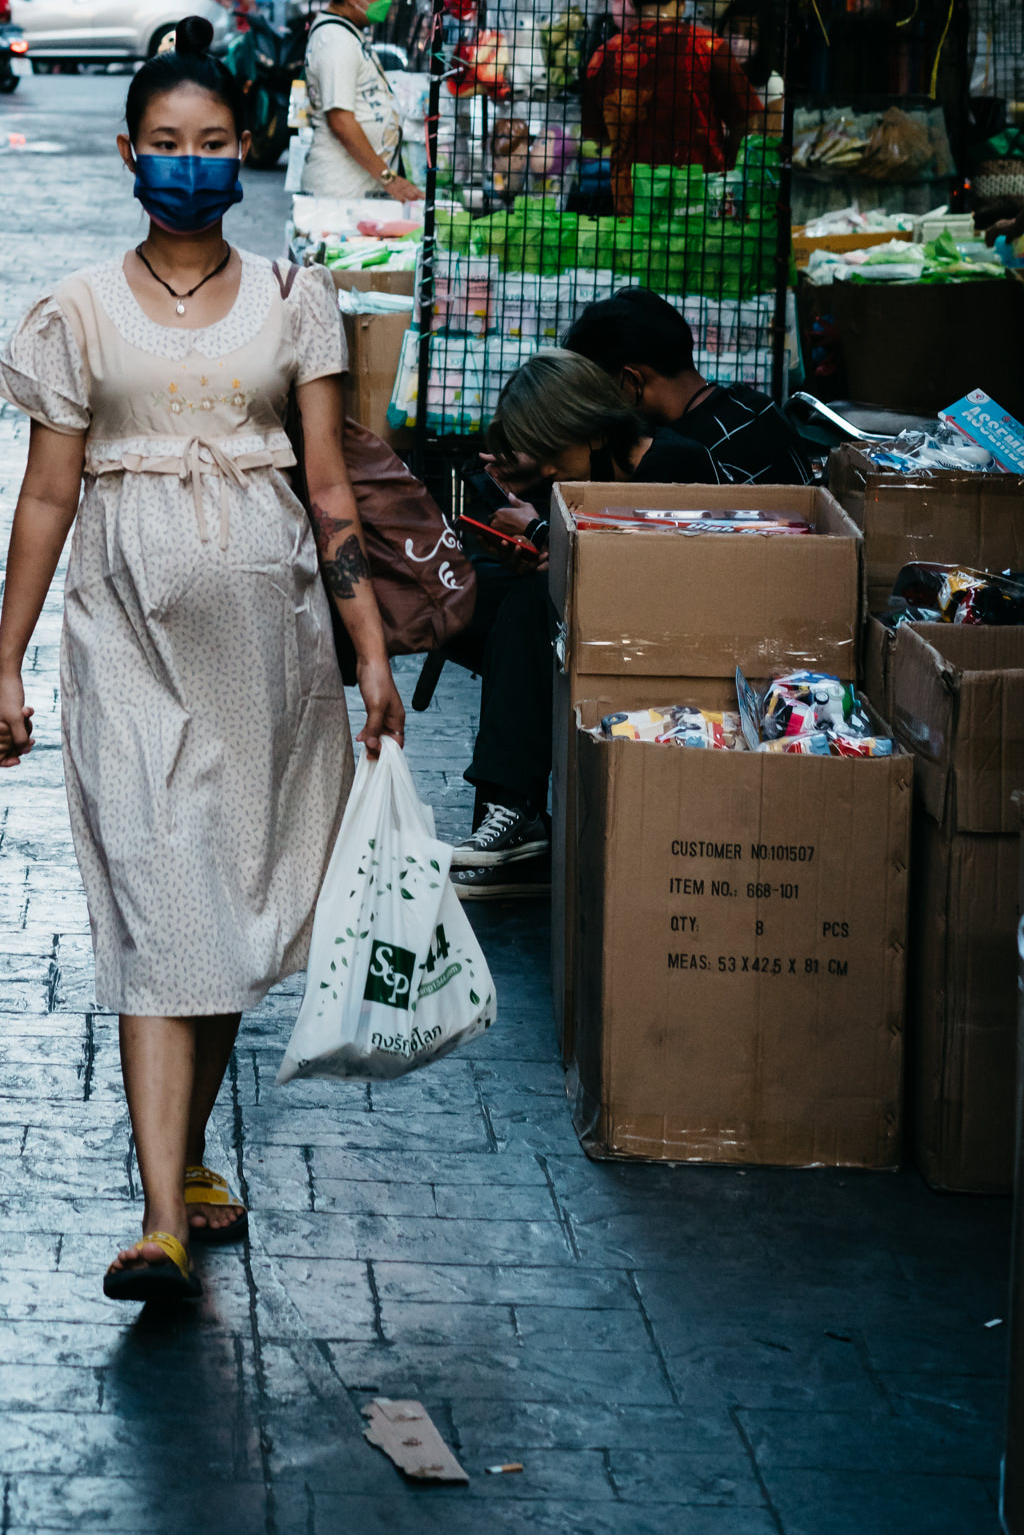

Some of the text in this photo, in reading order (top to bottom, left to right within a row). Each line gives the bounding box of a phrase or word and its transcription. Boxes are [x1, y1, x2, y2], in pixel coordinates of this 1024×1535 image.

[671, 840, 742, 859] CUSTOMER
[669, 877, 704, 895] ITEM
[747, 882, 799, 899] 668-101
[755, 920, 764, 936] 8
[822, 922, 849, 938] PCS
[369, 946, 410, 1003] S&P
[668, 953, 711, 970] MEAS:
[718, 956, 736, 972] 53
[788, 959, 796, 974] X
[804, 958, 819, 974] 81
[828, 959, 848, 976] CM
